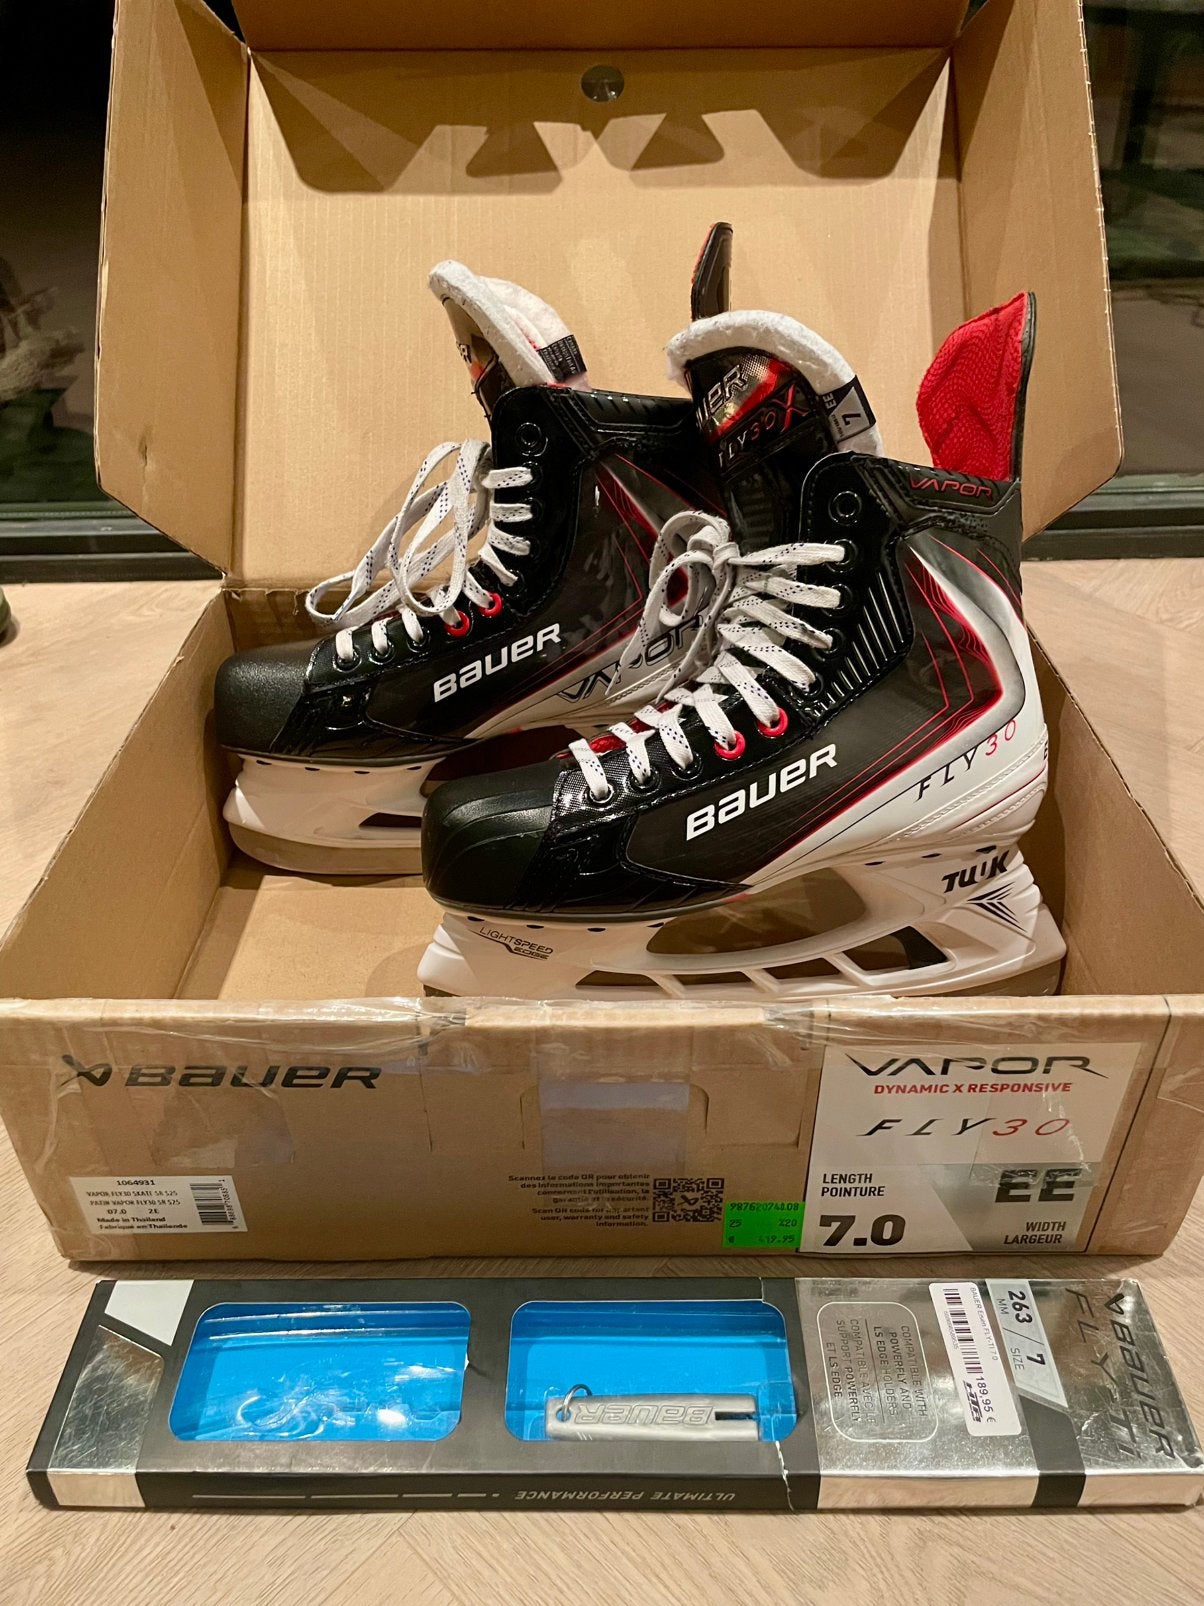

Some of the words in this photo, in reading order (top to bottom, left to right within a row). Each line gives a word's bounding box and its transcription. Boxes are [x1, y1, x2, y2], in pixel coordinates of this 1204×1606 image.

[842, 413, 861, 426] 7
[911, 478, 993, 501] VAPOR
[433, 622, 562, 702] BAUER
[914, 719, 1017, 802] FLY30
[686, 743, 838, 841] BAUER
[479, 927, 554, 954] LIGHTSPEED
[124, 1065, 382, 1089] BAUER
[845, 1053, 1109, 1079] VAPOR
[874, 1083, 949, 1095] DYNAMIC
[953, 1083, 965, 1094] X
[967, 1082, 1073, 1094] RESPONSIVE
[856, 1118, 1070, 1137] FLY30
[821, 1186, 885, 1197] POINTURE
[822, 1173, 873, 1184] LENGTH
[994, 1168, 1082, 1203] EE
[819, 1214, 906, 1247] 7.0
[1003, 1234, 1062, 1245] LARGEUR
[1025, 1221, 1066, 1232] WIDTH
[970, 1287, 981, 1310] BAUER
[873, 1326, 883, 1338] LS
[998, 1299, 1009, 1315] MM
[1010, 1347, 1025, 1370] SIZE
[1008, 1290, 1033, 1324] 263
[1027, 1353, 1046, 1366] 7
[826, 1342, 836, 1354] ET
[837, 1320, 852, 1364] SUPPORT
[876, 1340, 889, 1366] EDGE
[828, 1356, 839, 1369] LS
[850, 1319, 869, 1379] COMPATIBLE
[861, 1382, 875, 1410] AVEC
[889, 1332, 908, 1385] POWERFLY
[900, 1387, 912, 1410] AND
[900, 1325, 922, 1386] COMPATIBLE
[914, 1386, 928, 1417] WITH
[831, 1371, 843, 1398] EDGE
[844, 1367, 861, 1422] POWERFLY
[881, 1369, 899, 1415] HOLDERS
[976, 1377, 994, 1413] 189,95
[1111, 1319, 1176, 1459] BAUER
[574, 1403, 714, 1425] BAUER
[514, 1489, 645, 1501] PERFORMANCE
[650, 1490, 736, 1501] ULTIMATE
